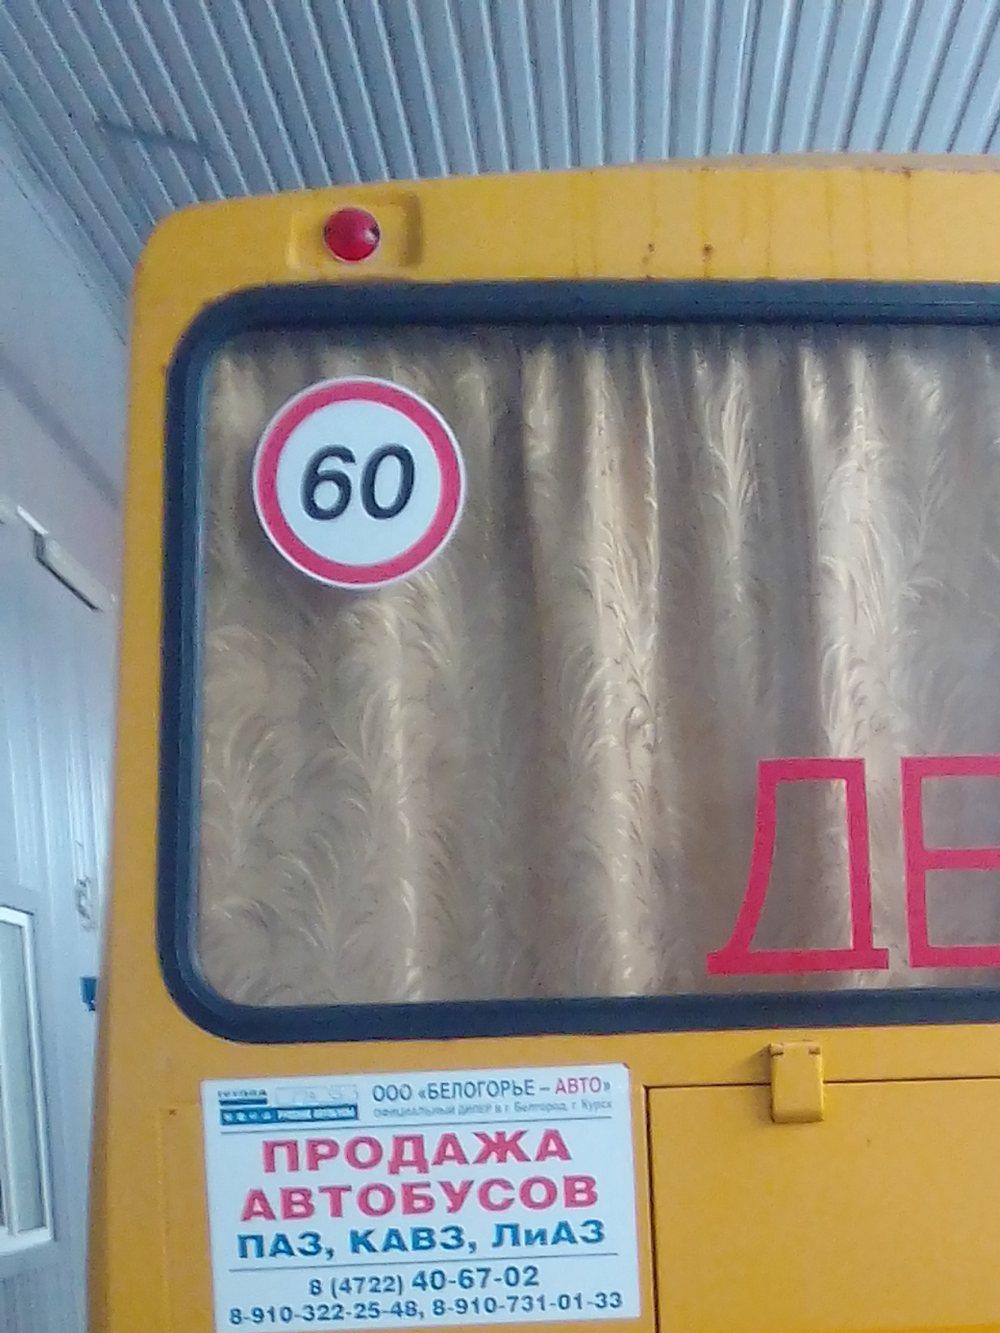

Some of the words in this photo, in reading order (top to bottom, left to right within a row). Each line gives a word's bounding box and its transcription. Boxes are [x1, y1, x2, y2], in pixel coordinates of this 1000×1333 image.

[302, 443, 416, 521] 60
[372, 1083, 412, 1102] ООО
[262, 1129, 571, 1175] ПРОДАЖА
[241, 1175, 598, 1222] АВТОБУСОВ
[237, 1231, 335, 1260] ПАЗ,
[350, 1225, 478, 1255] КАВЗ,
[491, 1219, 605, 1249] ЛиАЗ
[309, 1280, 323, 1297] 8
[331, 1274, 403, 1299] (4722)
[411, 1265, 540, 1292] 40-67-02
[229, 1301, 424, 1326] 8-910-322-25-48,
[432, 1291, 623, 1315] 8-910-731-01-33
